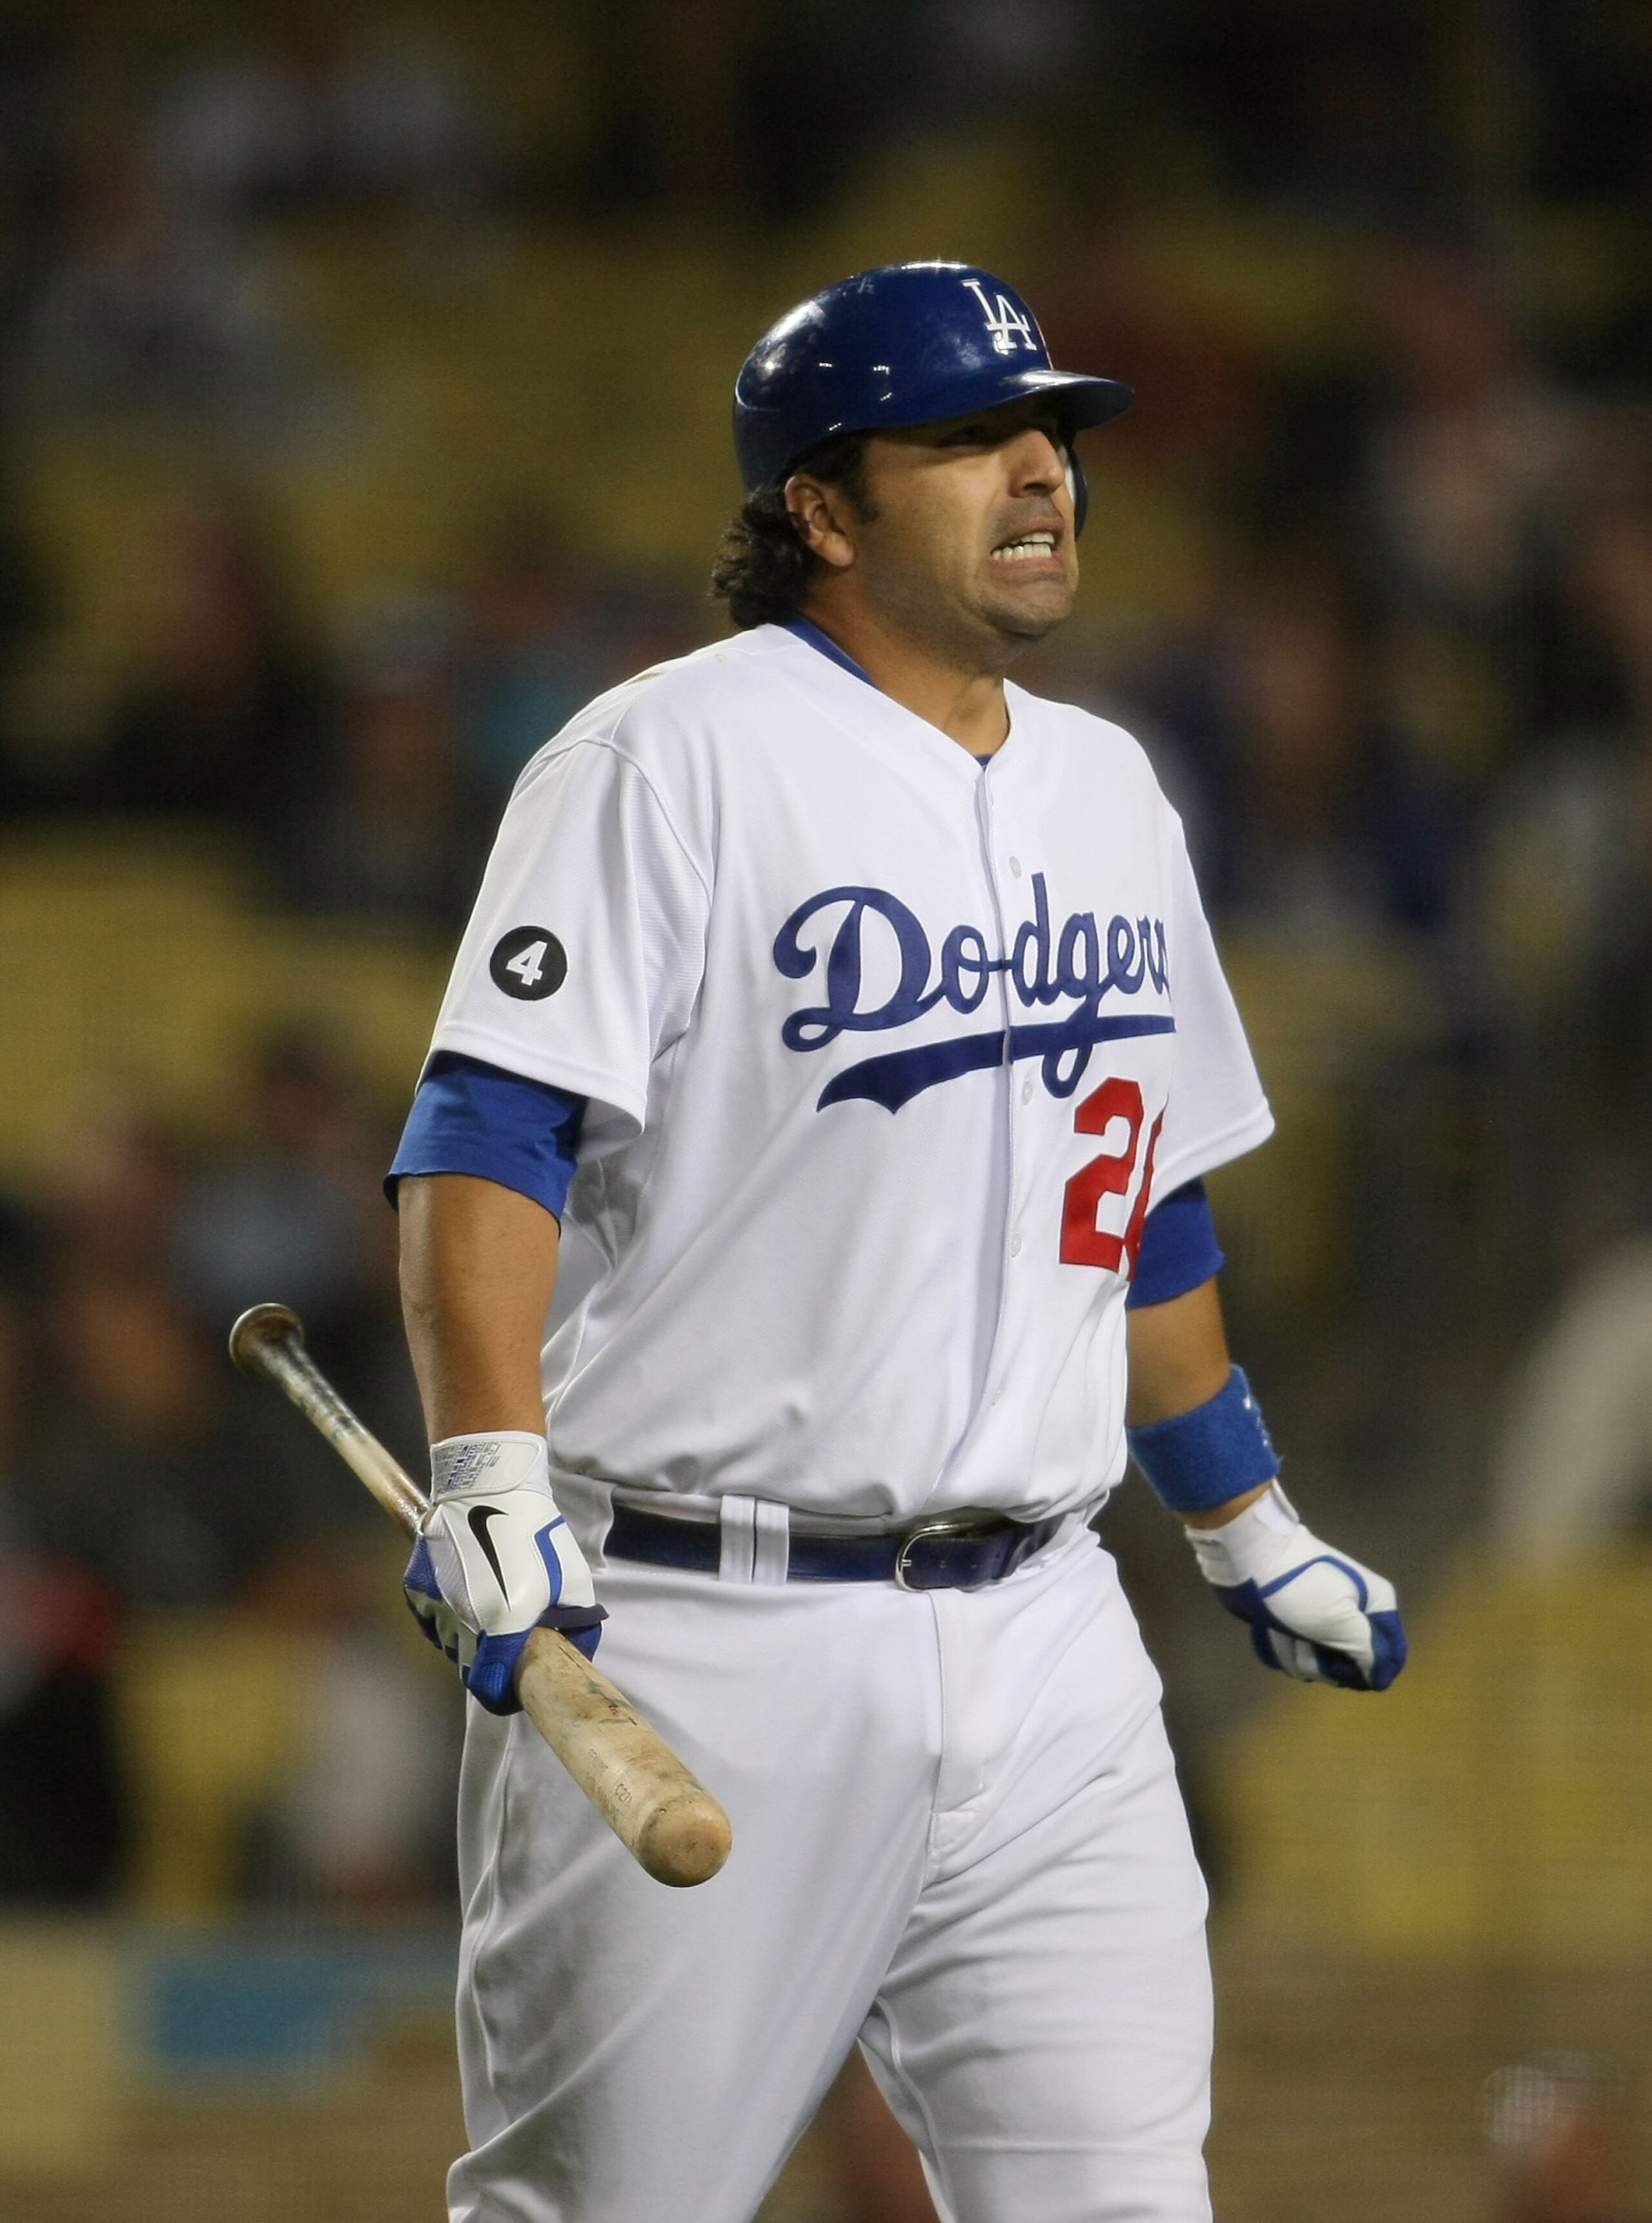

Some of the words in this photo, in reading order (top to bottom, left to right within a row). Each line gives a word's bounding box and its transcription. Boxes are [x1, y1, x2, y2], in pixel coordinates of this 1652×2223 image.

[961, 278, 1038, 355] LA
[506, 940, 548, 986] 4
[773, 871, 1173, 1099] Dodger
[1059, 1076, 1163, 1282] 2
